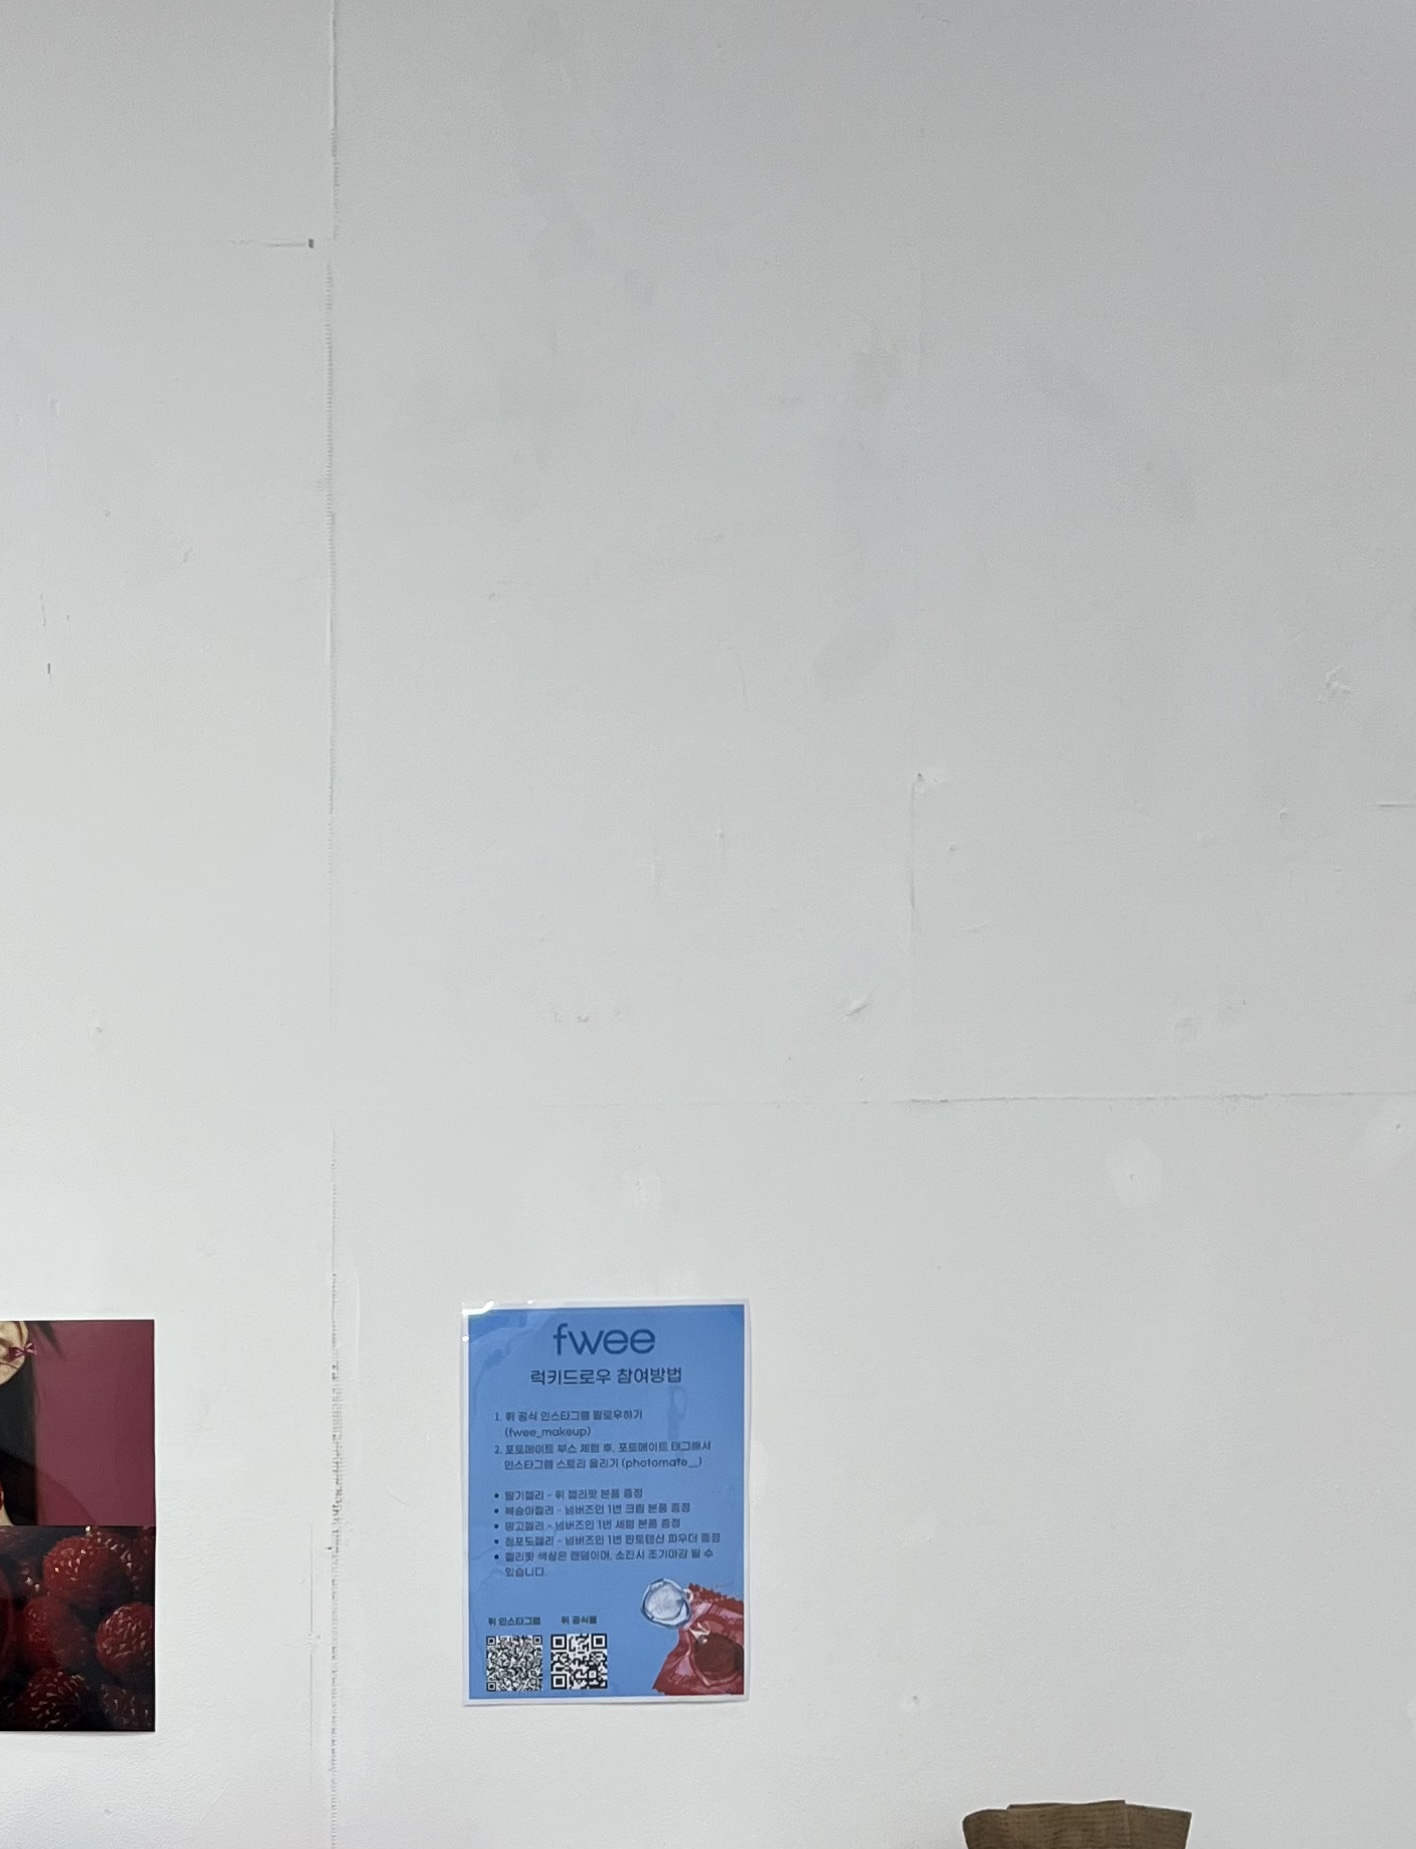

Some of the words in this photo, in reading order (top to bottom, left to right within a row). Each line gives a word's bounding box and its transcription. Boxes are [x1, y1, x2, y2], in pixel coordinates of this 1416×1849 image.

[552, 1322, 656, 1356] fwee
[530, 1367, 612, 1387] 럭키드로우
[616, 1366, 682, 1385] 참여방법
[518, 1411, 537, 1422] 공식
[540, 1410, 590, 1421] 인스타그램
[593, 1409, 643, 1421] 팔로우하기
[504, 1425, 591, 1438] (fwee_makeup)
[505, 1443, 554, 1455] 포토메이트
[557, 1443, 577, 1454] 부스
[618, 1441, 667, 1453] 포토메이트
[671, 1440, 712, 1452] 태그해서
[504, 1459, 554, 1471] 인스타그램
[556, 1458, 586, 1469] 스토리
[589, 1457, 619, 1469] 올리기
[504, 1490, 544, 1501] 딸기젤리
[600, 1487, 620, 1499] 본품
[623, 1487, 643, 1499] 증정
[505, 1504, 554, 1517] 복숭아젤리
[565, 1504, 604, 1515] 넘버즈인
[607, 1504, 622, 1514] 1번
[625, 1503, 645, 1514] 크림
[648, 1502, 667, 1514] 본품
[671, 1502, 691, 1513] 증정
[504, 1520, 544, 1532] 망고젤리
[555, 1519, 594, 1531] 넘버즈인
[597, 1519, 612, 1530] 1번
[638, 1518, 657, 1529] 본품
[661, 1518, 681, 1529] 증정
[565, 1535, 604, 1546] 넘버즈인
[607, 1534, 622, 1545] 1번
[668, 1533, 698, 1544] 파우더
[537, 1551, 567, 1562] 색상은
[615, 1549, 645, 1560] 소진시
[648, 1548, 688, 1559] 조기마감
[704, 1547, 714, 1558] 수
